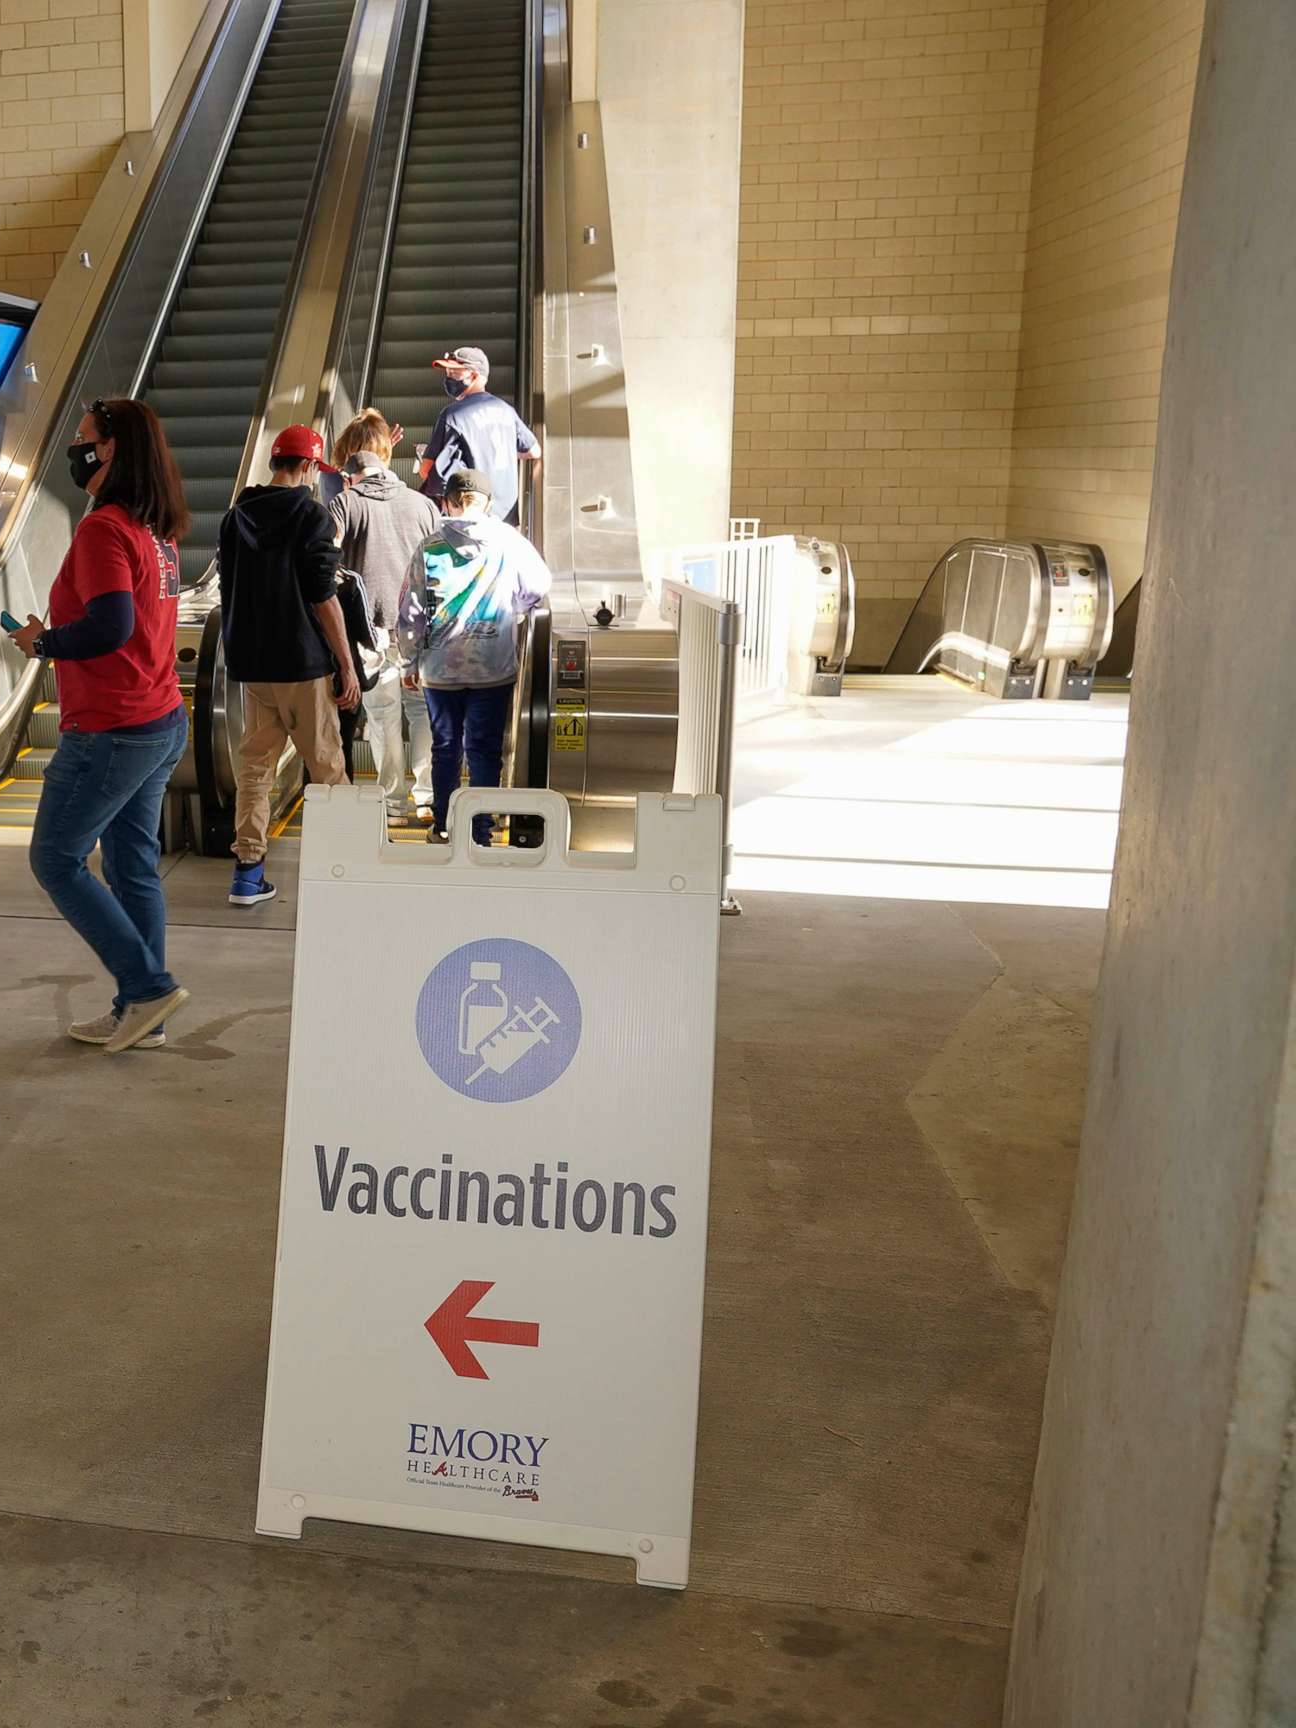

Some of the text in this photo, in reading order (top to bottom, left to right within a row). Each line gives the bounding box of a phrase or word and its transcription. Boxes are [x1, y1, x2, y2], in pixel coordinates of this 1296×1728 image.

[313, 1144, 678, 1239] Vaccinations
[407, 1423, 550, 1468] EMORY
[407, 1459, 540, 1487] HEALTHCARE
